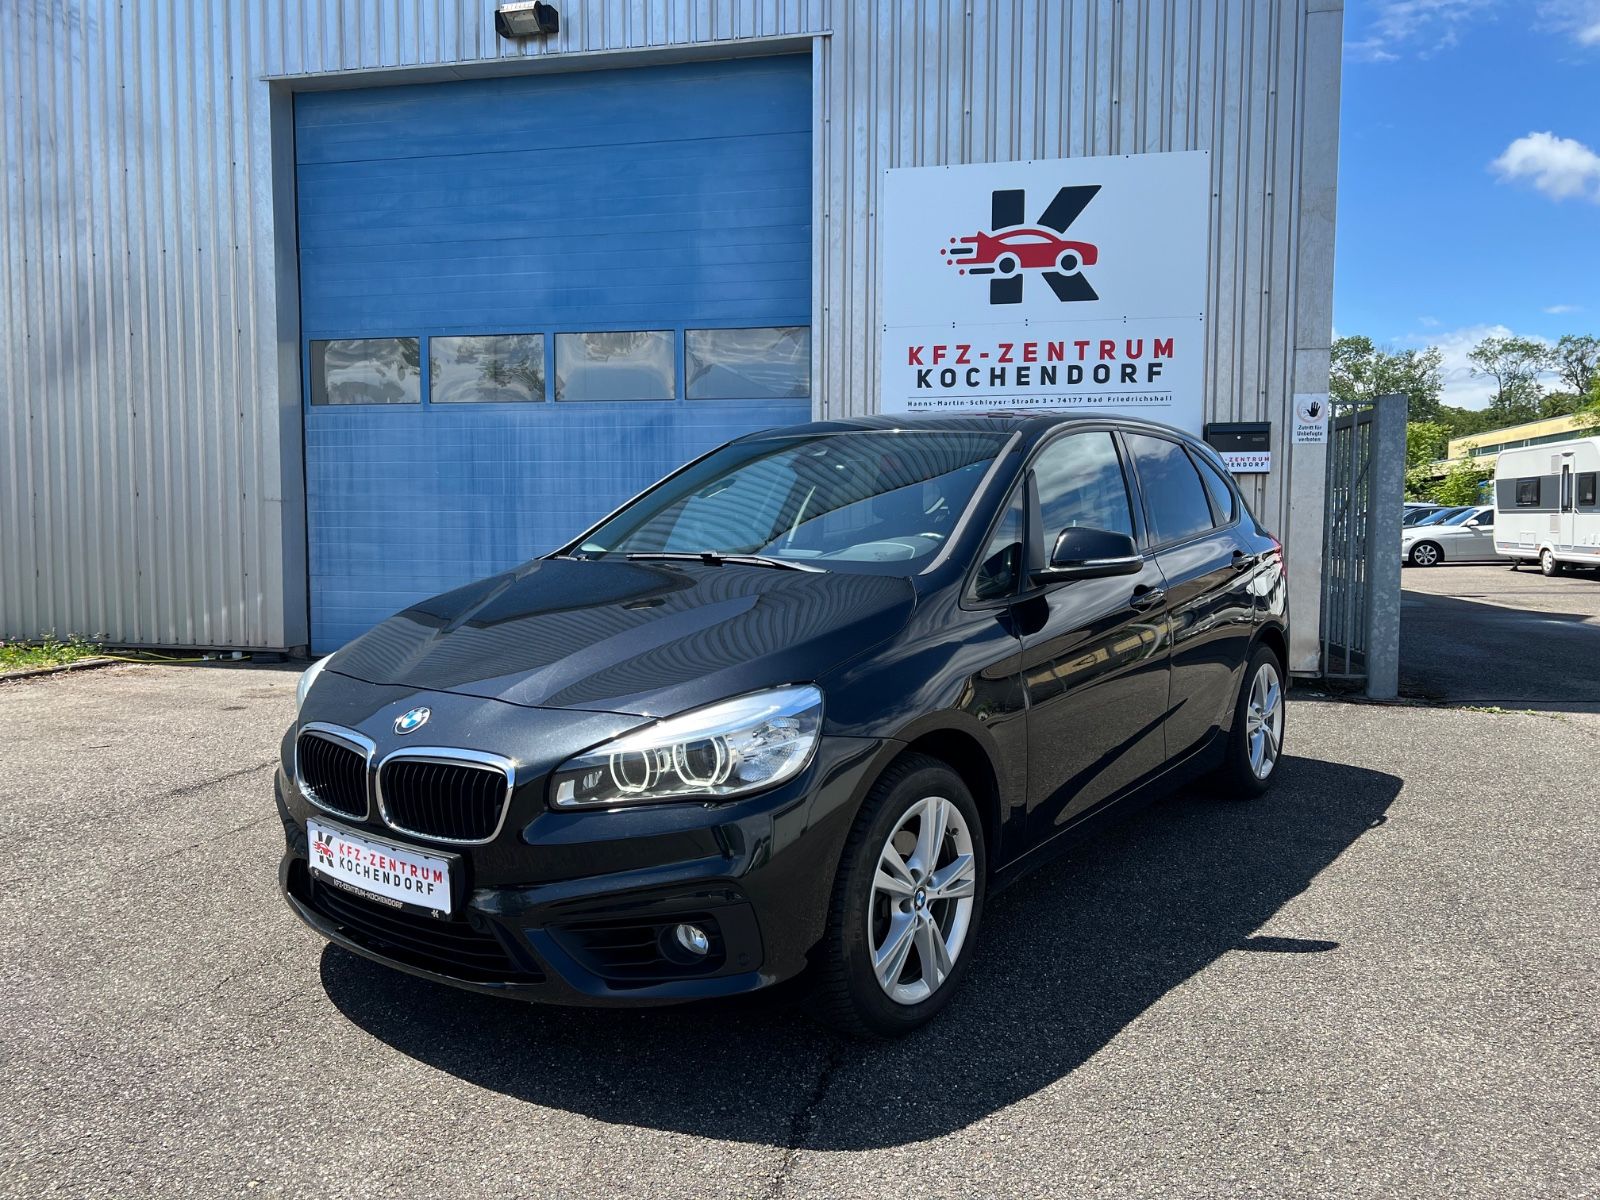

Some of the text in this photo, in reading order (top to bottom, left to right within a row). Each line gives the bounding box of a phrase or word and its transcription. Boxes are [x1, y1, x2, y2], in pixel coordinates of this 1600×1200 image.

[908, 338, 1174, 366] KFZ-ZENTRUM
[917, 362, 1163, 389] KOCHENDORF
[339, 842, 443, 884] KFZ-ZENTRUM
[339, 857, 435, 896] KOCHENDORF
